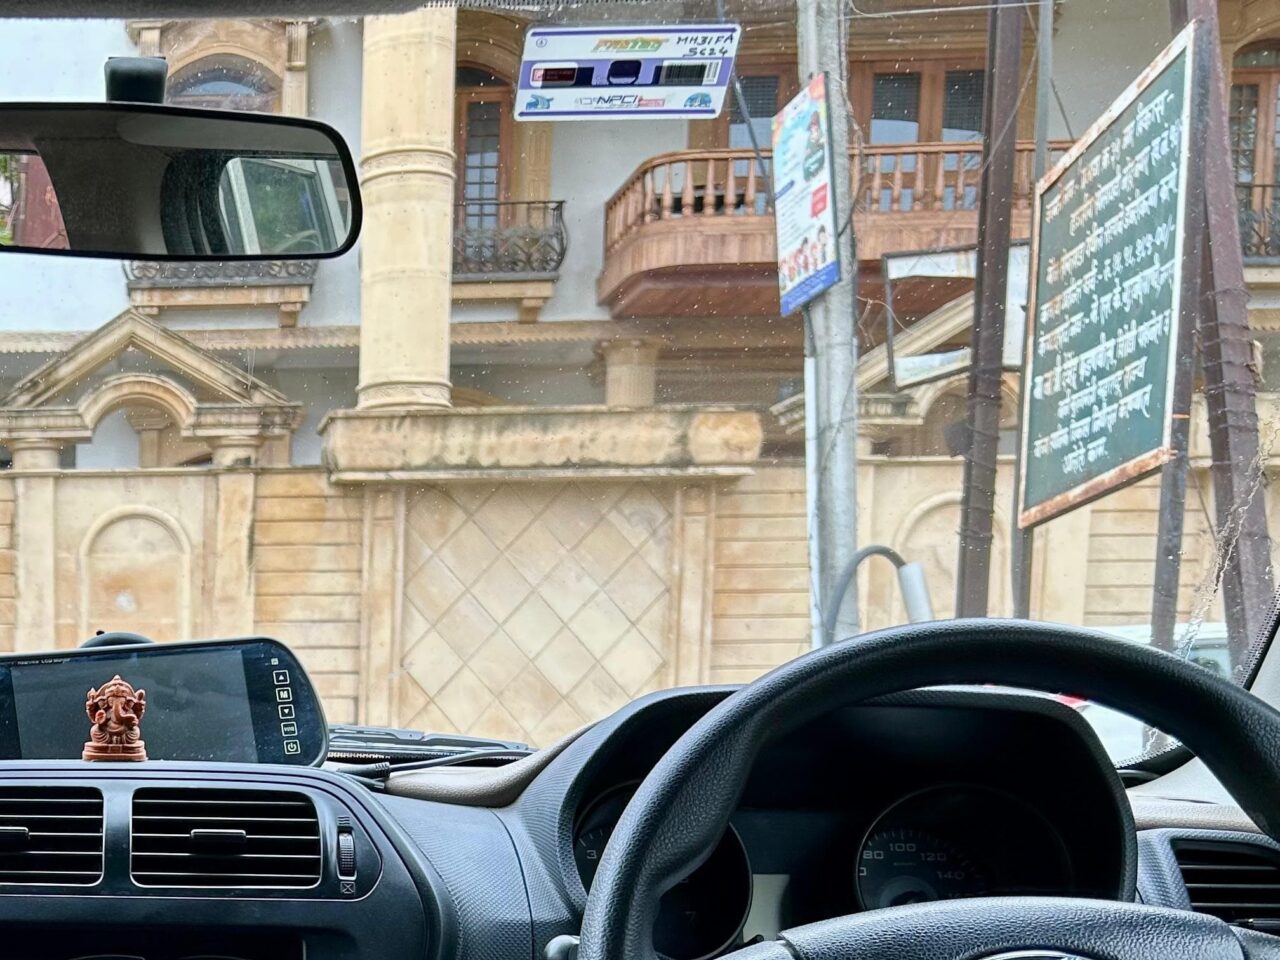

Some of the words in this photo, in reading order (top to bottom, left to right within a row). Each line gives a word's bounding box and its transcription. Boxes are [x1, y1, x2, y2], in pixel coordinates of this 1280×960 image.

[279, 690, 288, 699] M
[888, 843, 917, 852] 100
[586, 849, 598, 860] 3
[863, 850, 885, 859] 80
[920, 852, 947, 861] 120
